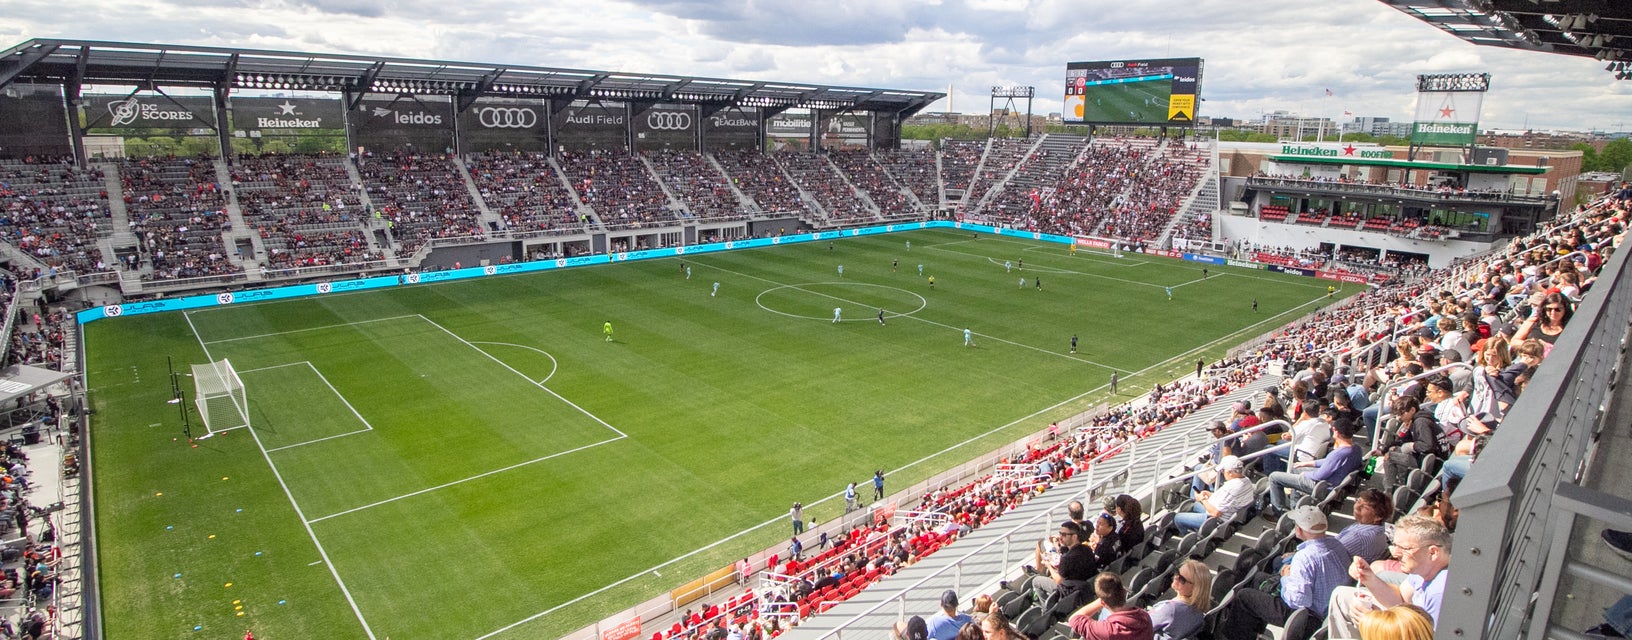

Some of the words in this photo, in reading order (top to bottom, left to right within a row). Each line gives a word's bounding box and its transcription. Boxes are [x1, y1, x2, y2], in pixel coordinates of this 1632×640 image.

[141, 103, 158, 111] DC
[142, 110, 193, 120] SCORES
[395, 110, 442, 125] leidos
[565, 114, 594, 125] Audi
[597, 115, 623, 125] Field
[257, 117, 319, 128] Heineken
[1417, 123, 1470, 134] Heineken
[1281, 144, 1338, 157] Heineken
[1227, 259, 1258, 269] Heineken
[1284, 268, 1303, 276] leidos
